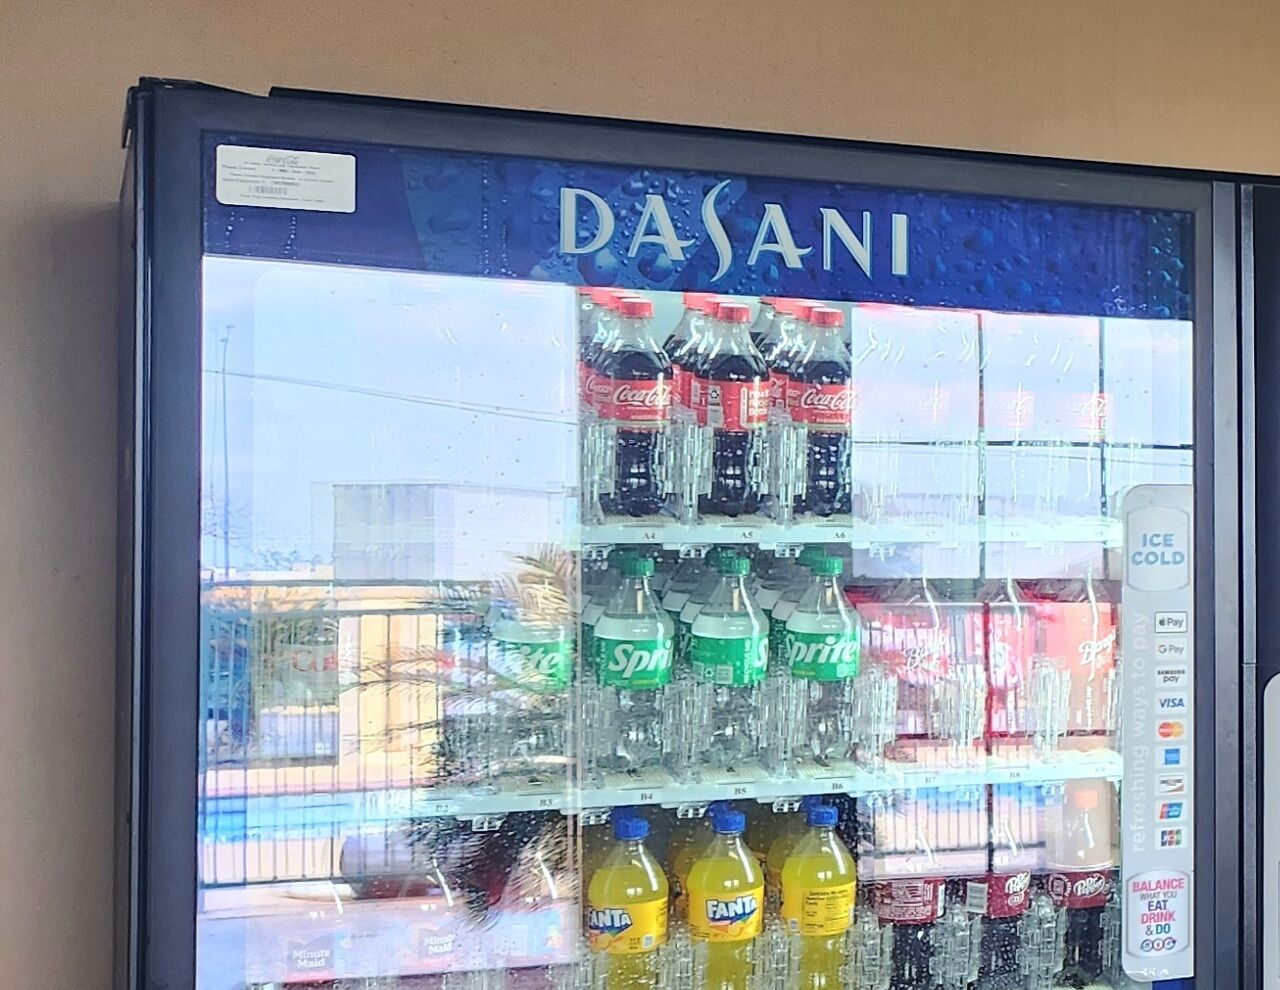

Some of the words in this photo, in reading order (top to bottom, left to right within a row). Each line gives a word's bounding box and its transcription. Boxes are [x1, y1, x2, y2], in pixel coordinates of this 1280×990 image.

[560, 179, 909, 283] DASANI
[613, 384, 672, 406] Coca-Cola
[801, 388, 859, 411] Coca-Cola
[1142, 533, 1174, 548] ICE
[1131, 551, 1185, 565] COLD
[1166, 617, 1184, 628] Pay
[1133, 610, 1149, 651] pay
[786, 633, 855, 667] Sprite
[1168, 644, 1184, 655] Pay
[608, 639, 673, 680] Spri
[1130, 657, 1146, 678] to
[1163, 675, 1180, 684] pay
[1159, 698, 1185, 708] VISA
[1133, 686, 1149, 739] ways
[1129, 744, 1149, 852] refreshing
[1132, 878, 1185, 893] BALANCE
[1140, 891, 1161, 901] WHAT
[1163, 890, 1177, 899] YOU
[705, 895, 758, 920] FANTA
[1147, 899, 1168, 912] EAT
[1141, 910, 1176, 924] DRINK
[1145, 924, 1153, 936] &
[1155, 923, 1171, 935] DO
[296, 958, 326, 969] Maid
